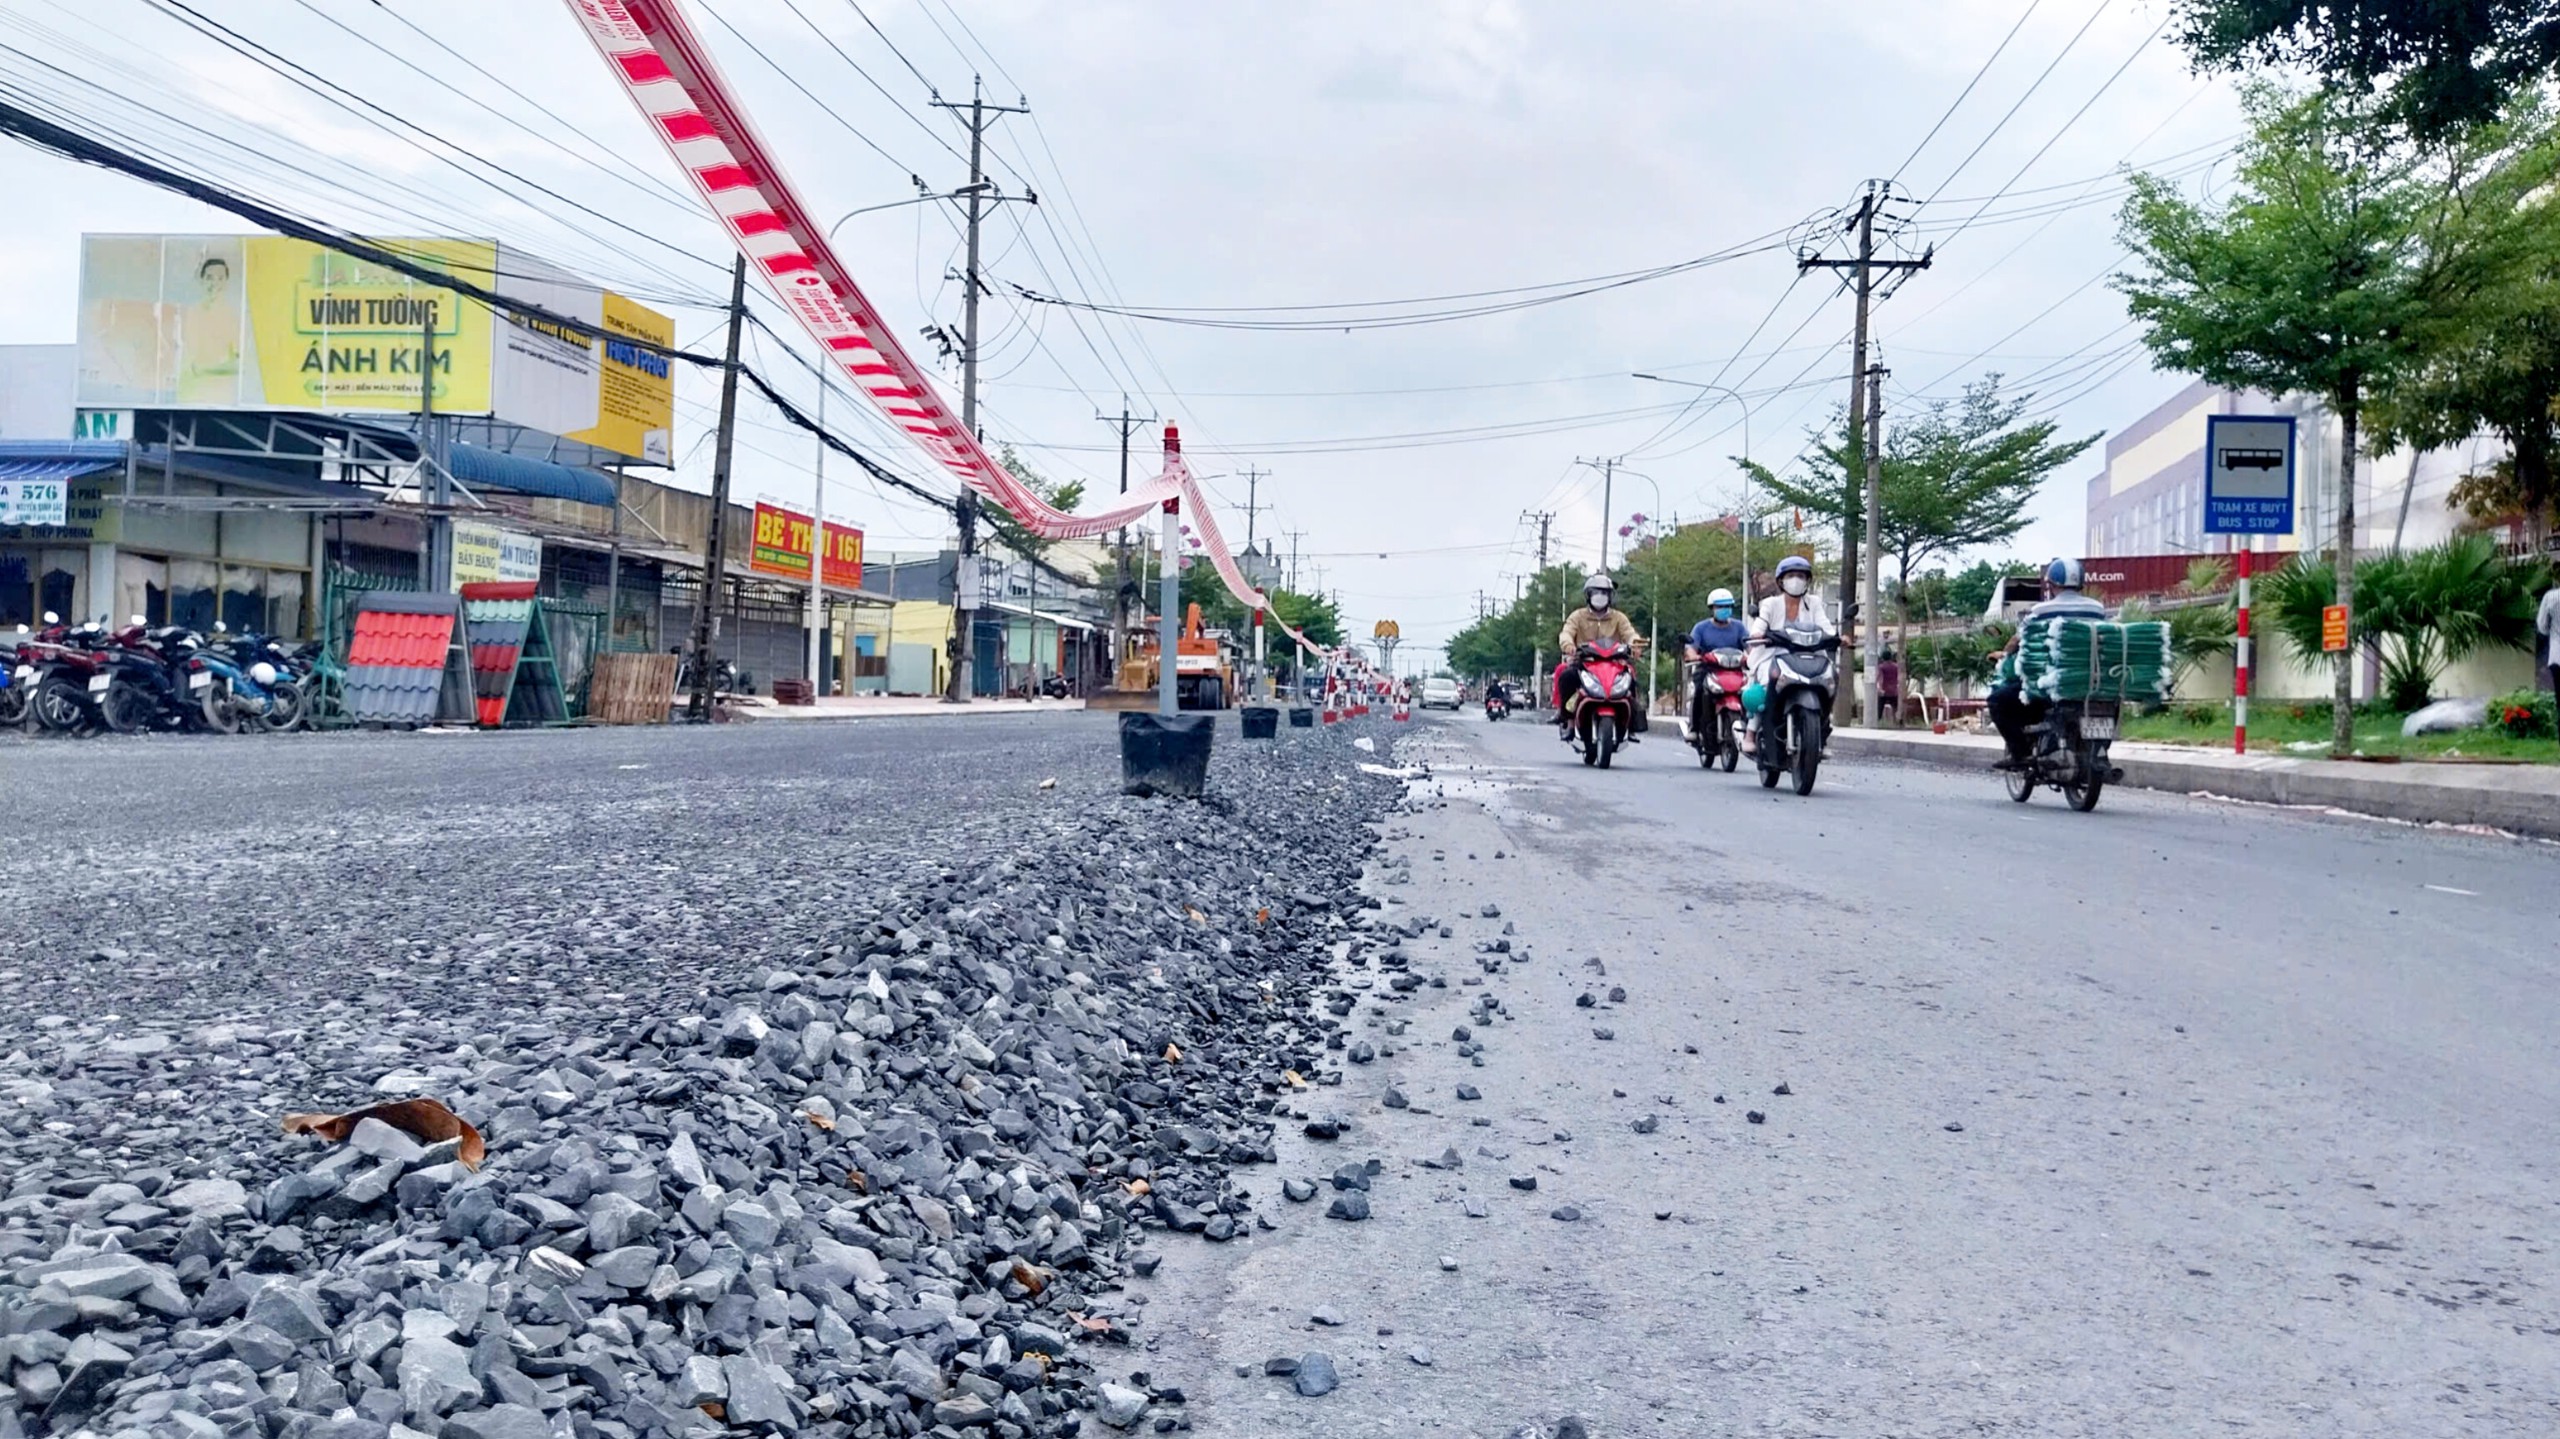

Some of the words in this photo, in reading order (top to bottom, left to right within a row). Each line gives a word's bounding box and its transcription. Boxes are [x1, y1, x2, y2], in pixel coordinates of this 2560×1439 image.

[300, 339, 377, 374] ÁNH
[21, 484, 58, 501] 576
[2243, 502, 2258, 514] XE
[2217, 516, 2242, 528] BUS
[2248, 517, 2280, 528] STOP
[757, 510, 786, 548] BÊ
[837, 533, 862, 565] 161
